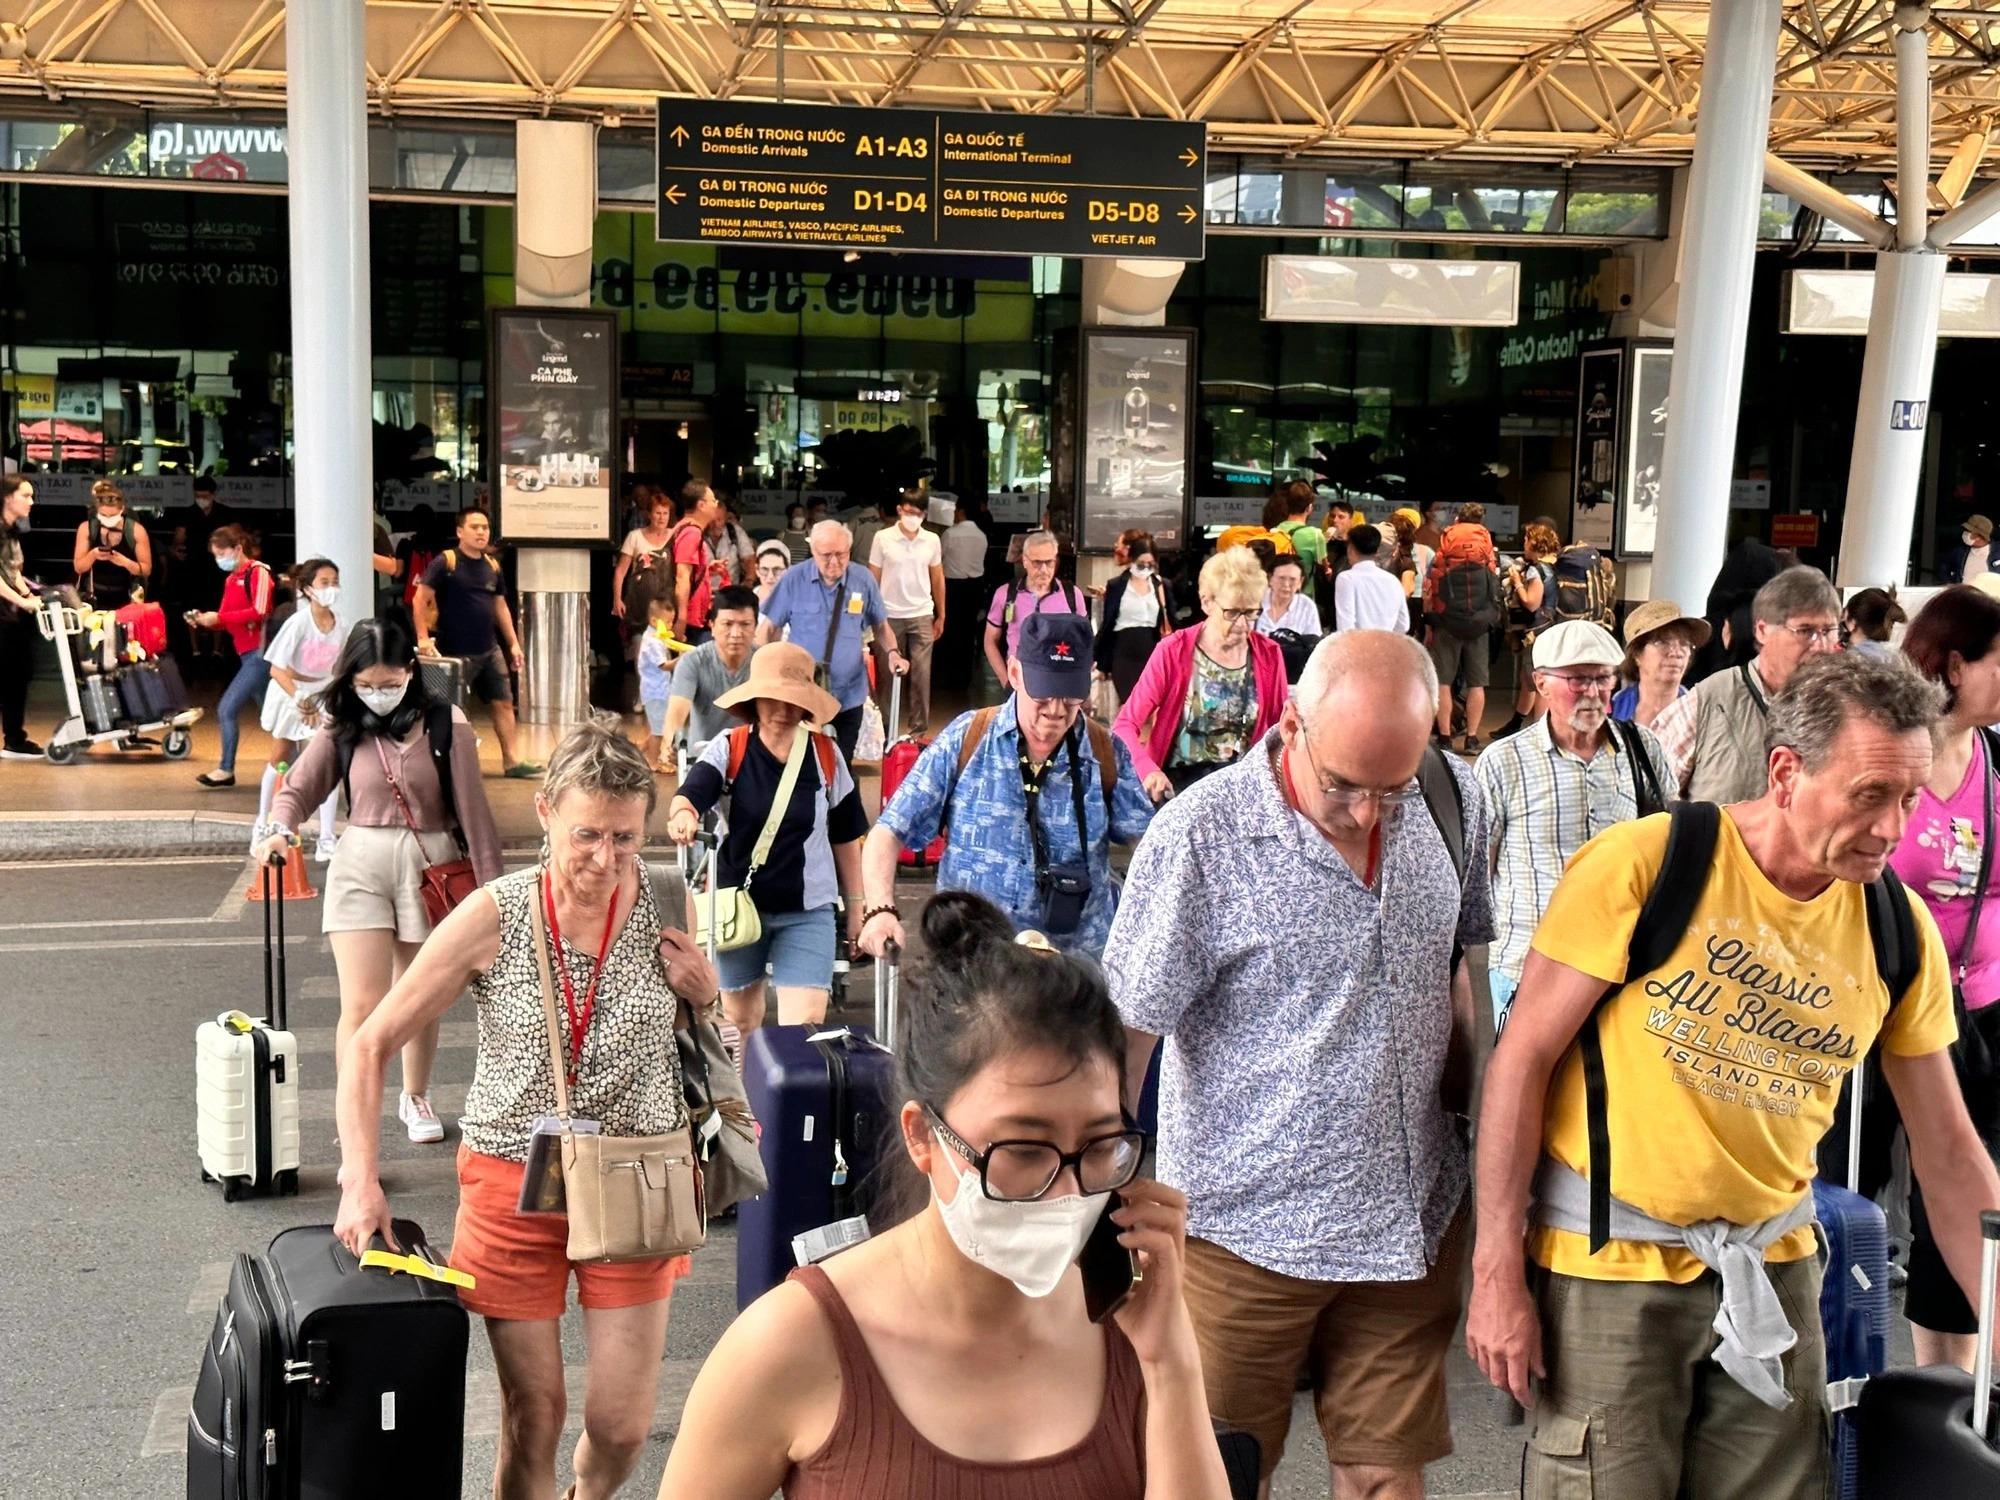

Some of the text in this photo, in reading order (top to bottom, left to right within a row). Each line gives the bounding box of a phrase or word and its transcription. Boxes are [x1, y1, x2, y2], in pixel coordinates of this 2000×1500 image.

[701, 123, 846, 143] GA ĐẾN TRONG NƯỚC
[944, 130, 1025, 147] GA QUỐC TẾ
[701, 141, 809, 157] Domestic Arrivals
[855, 135, 928, 159] A1-A3
[944, 148, 1072, 164] International Terminal
[699, 178, 828, 196] GA ĐI TRONG NƯỚC
[699, 195, 825, 212] Domestic Departures
[854, 190, 928, 213] D1-D4
[943, 188, 1068, 205] GA ĐI TRONG NƯỚC
[943, 205, 1065, 221] Domestic Departures
[1088, 200, 1160, 224] D5-D8
[701, 218, 904, 235] VIETNAM AIRLINES, VASCO, PACIFIC AIRLINES,
[701, 228, 887, 243] BAMBOO AIRWAYS & VIETRAVEL AIRLINES
[1091, 233, 1157, 246] VIETJET AIR
[530, 373, 555, 382] PHIN
[141, 480, 164, 489] TAXI
[406, 486, 430, 495] TAXI
[1223, 502, 1245, 511] TAXI
[1706, 934, 1834, 1009] Classic
[1644, 970, 1859, 1060] All Blacks
[1646, 1006, 1847, 1082] WELLINGTON
[1662, 1046, 1813, 1100] ISLAND BAY
[1671, 1068, 1801, 1118] BEACH RUGBY
[937, 1125, 970, 1161] CHANEL
